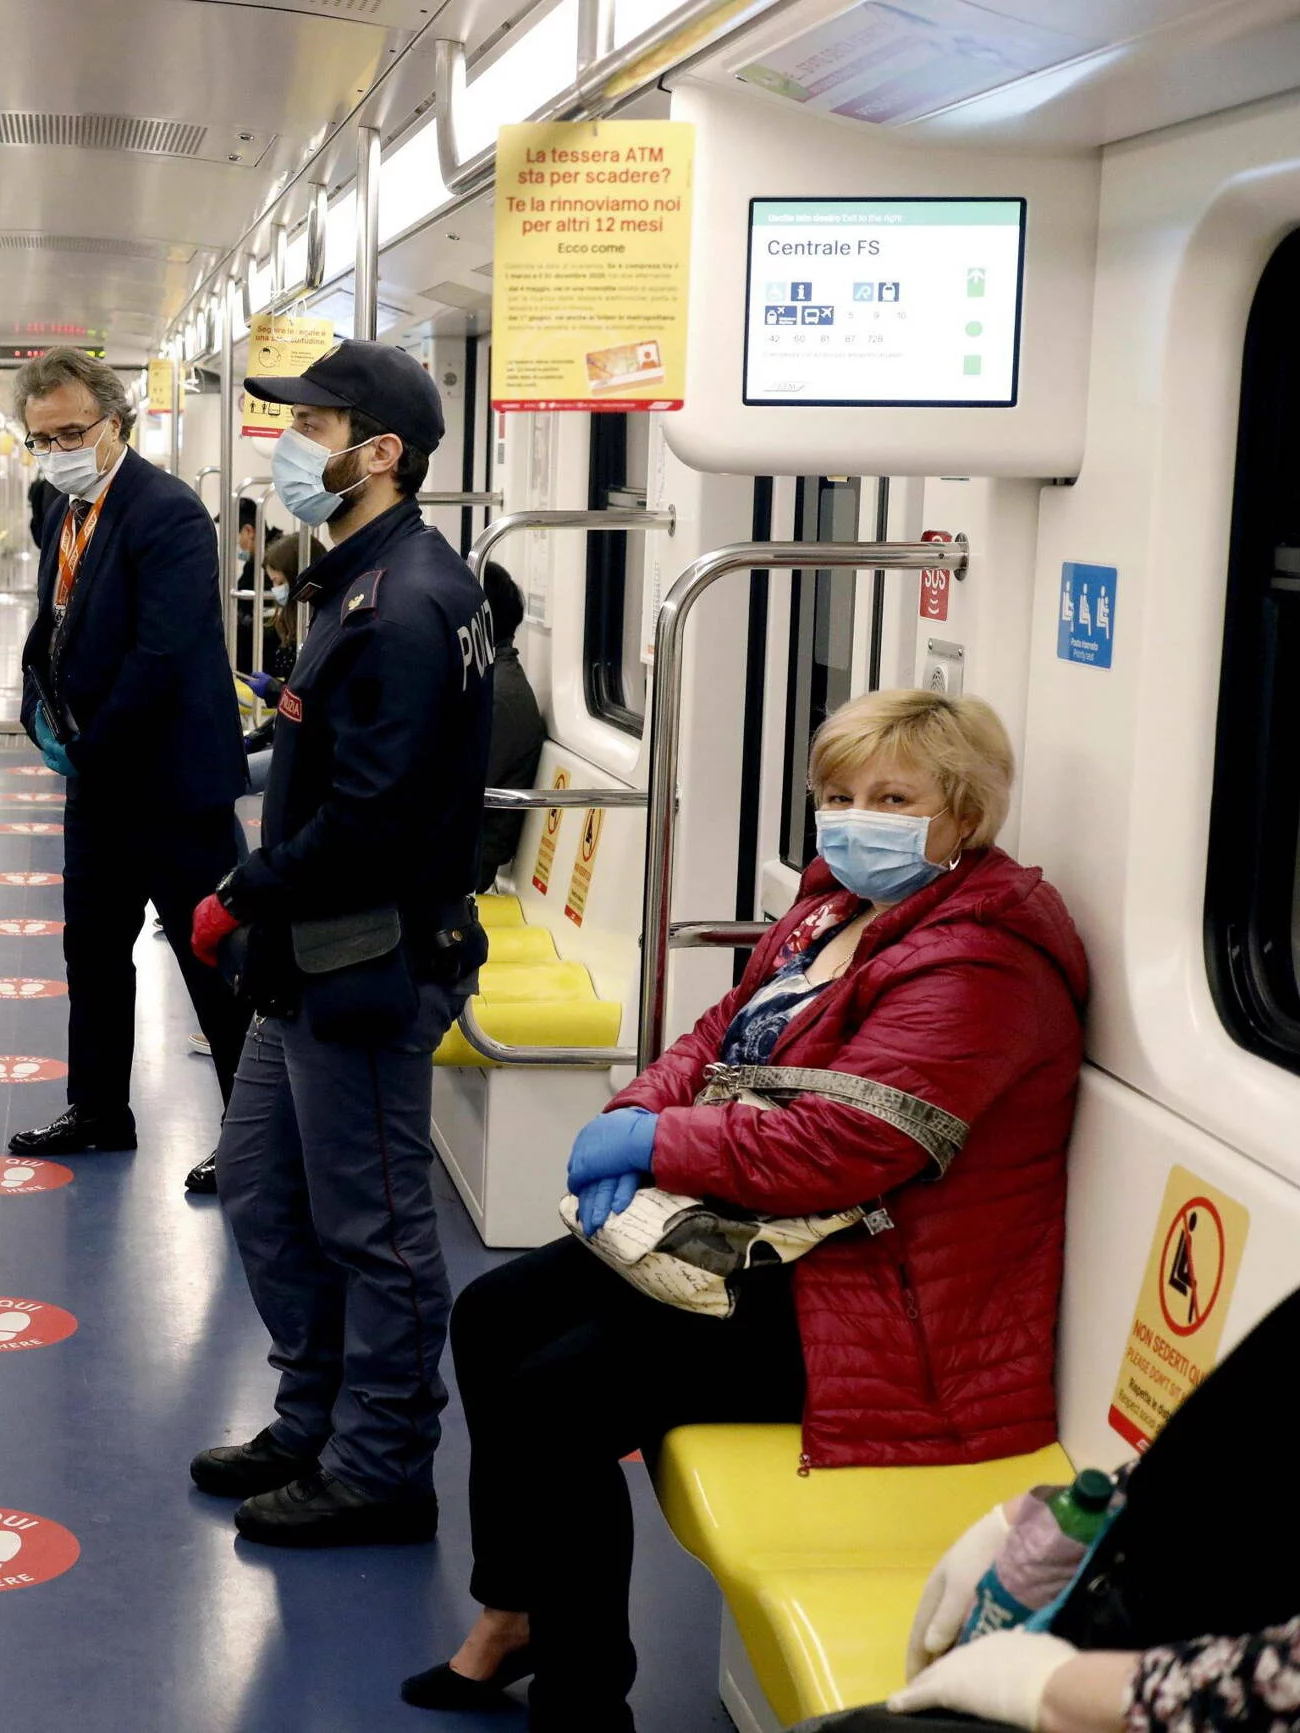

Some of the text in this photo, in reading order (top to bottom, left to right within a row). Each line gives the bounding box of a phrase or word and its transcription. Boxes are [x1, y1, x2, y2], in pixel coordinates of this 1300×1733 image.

[526, 147, 664, 163] La tessera ATM
[518, 169, 671, 188] sta per scadere?
[506, 196, 681, 212] Te la rinnoviamo noi
[522, 217, 663, 236] per altri 12 mesi
[558, 243, 626, 254] Ecco come
[767, 240, 880, 256] Centrale FS
[5, 1158, 45, 1167] QUI
[6, 1184, 46, 1193] HERE
[1134, 1319, 1153, 1346] NON
[1151, 1335, 1190, 1377] SEDERTI
